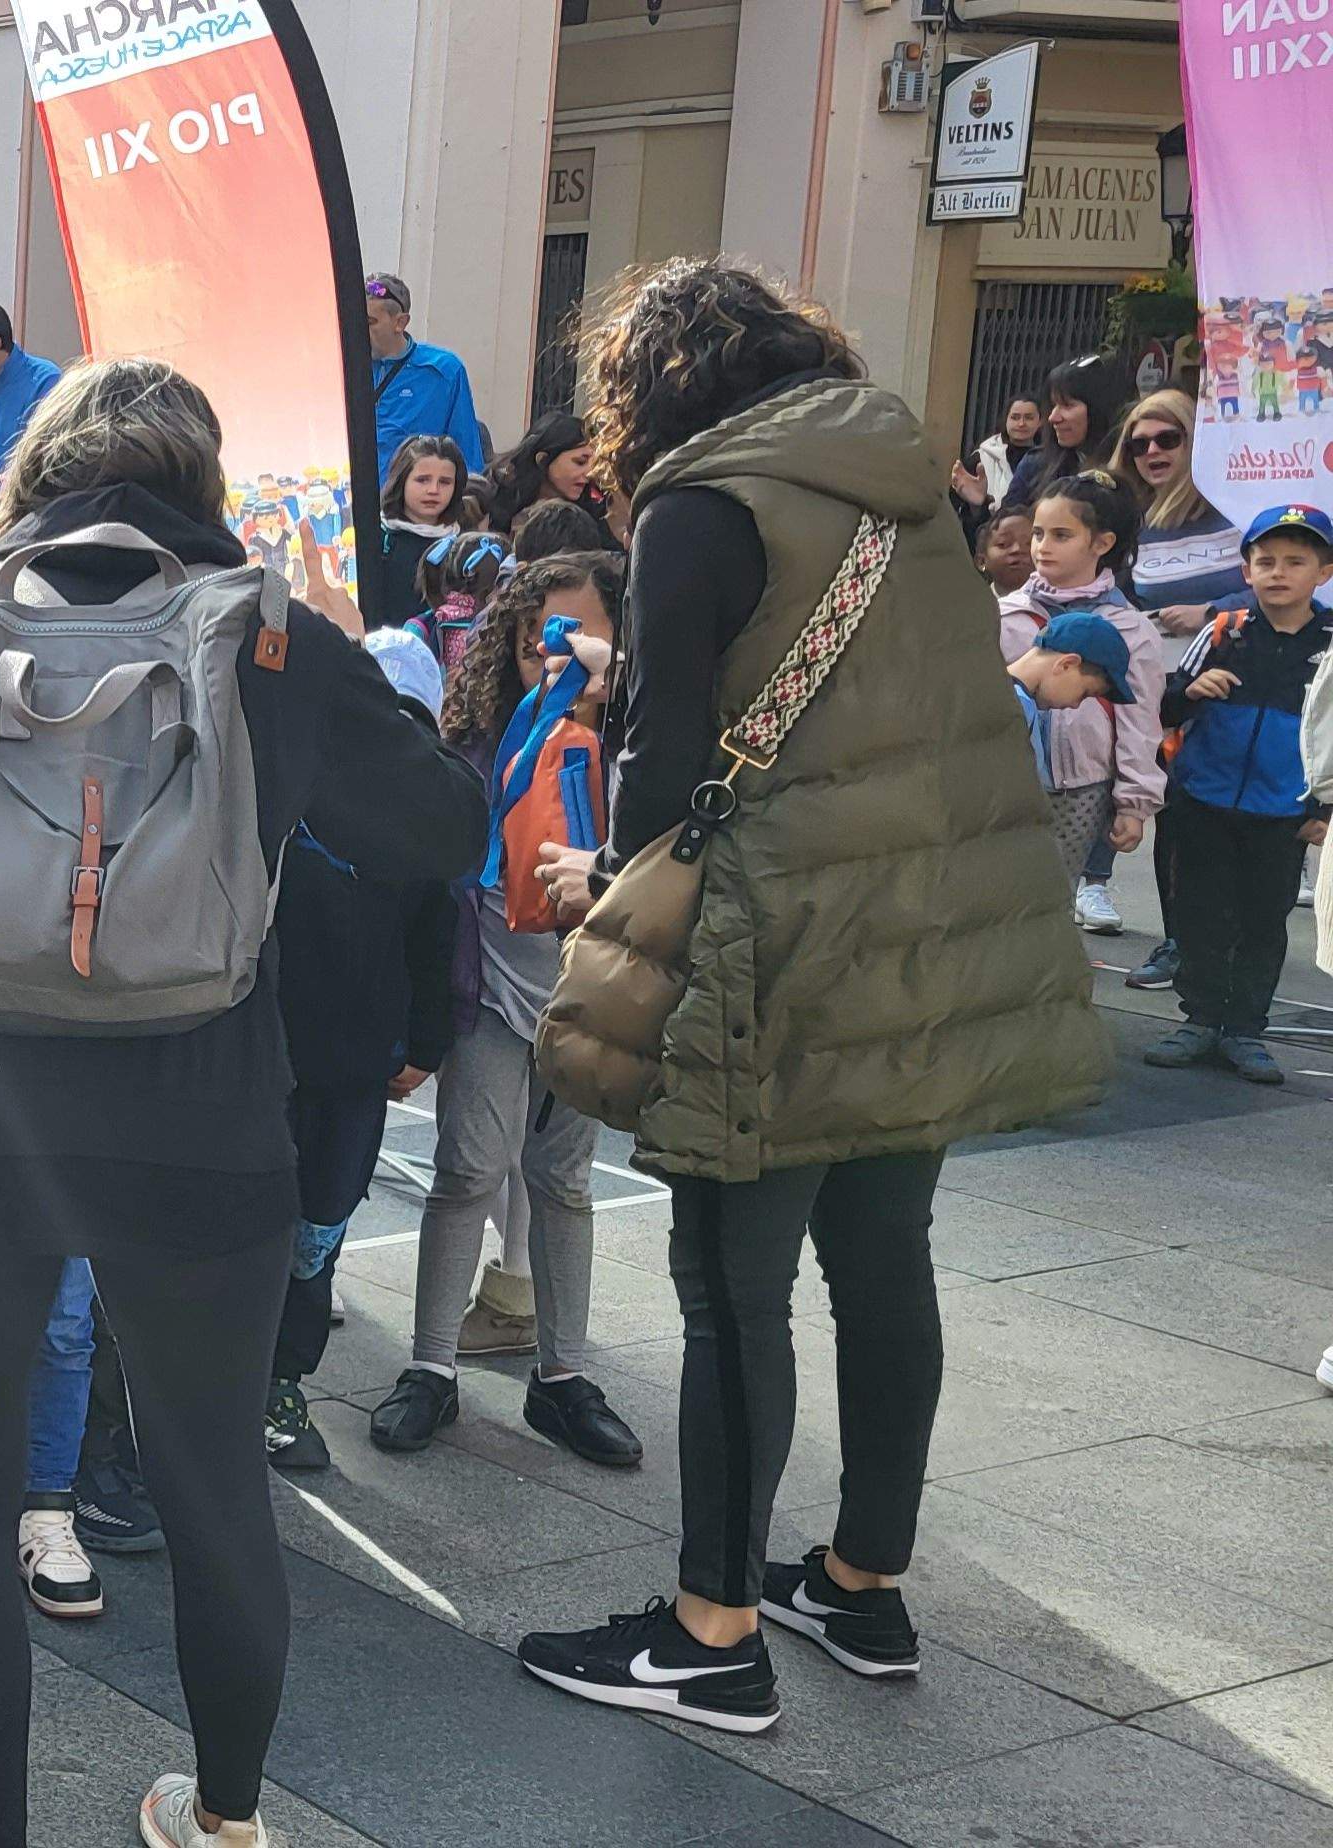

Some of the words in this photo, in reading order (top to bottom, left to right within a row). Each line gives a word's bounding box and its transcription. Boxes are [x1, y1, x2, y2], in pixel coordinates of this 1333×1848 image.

[947, 121, 1014, 144] VELTINS
[1026, 165, 1157, 202] LMACENES
[937, 192, 958, 212] Alt
[962, 190, 1011, 211] Berlin
[1070, 207, 1141, 242] JUAN
[1142, 546, 1233, 569] GANT
